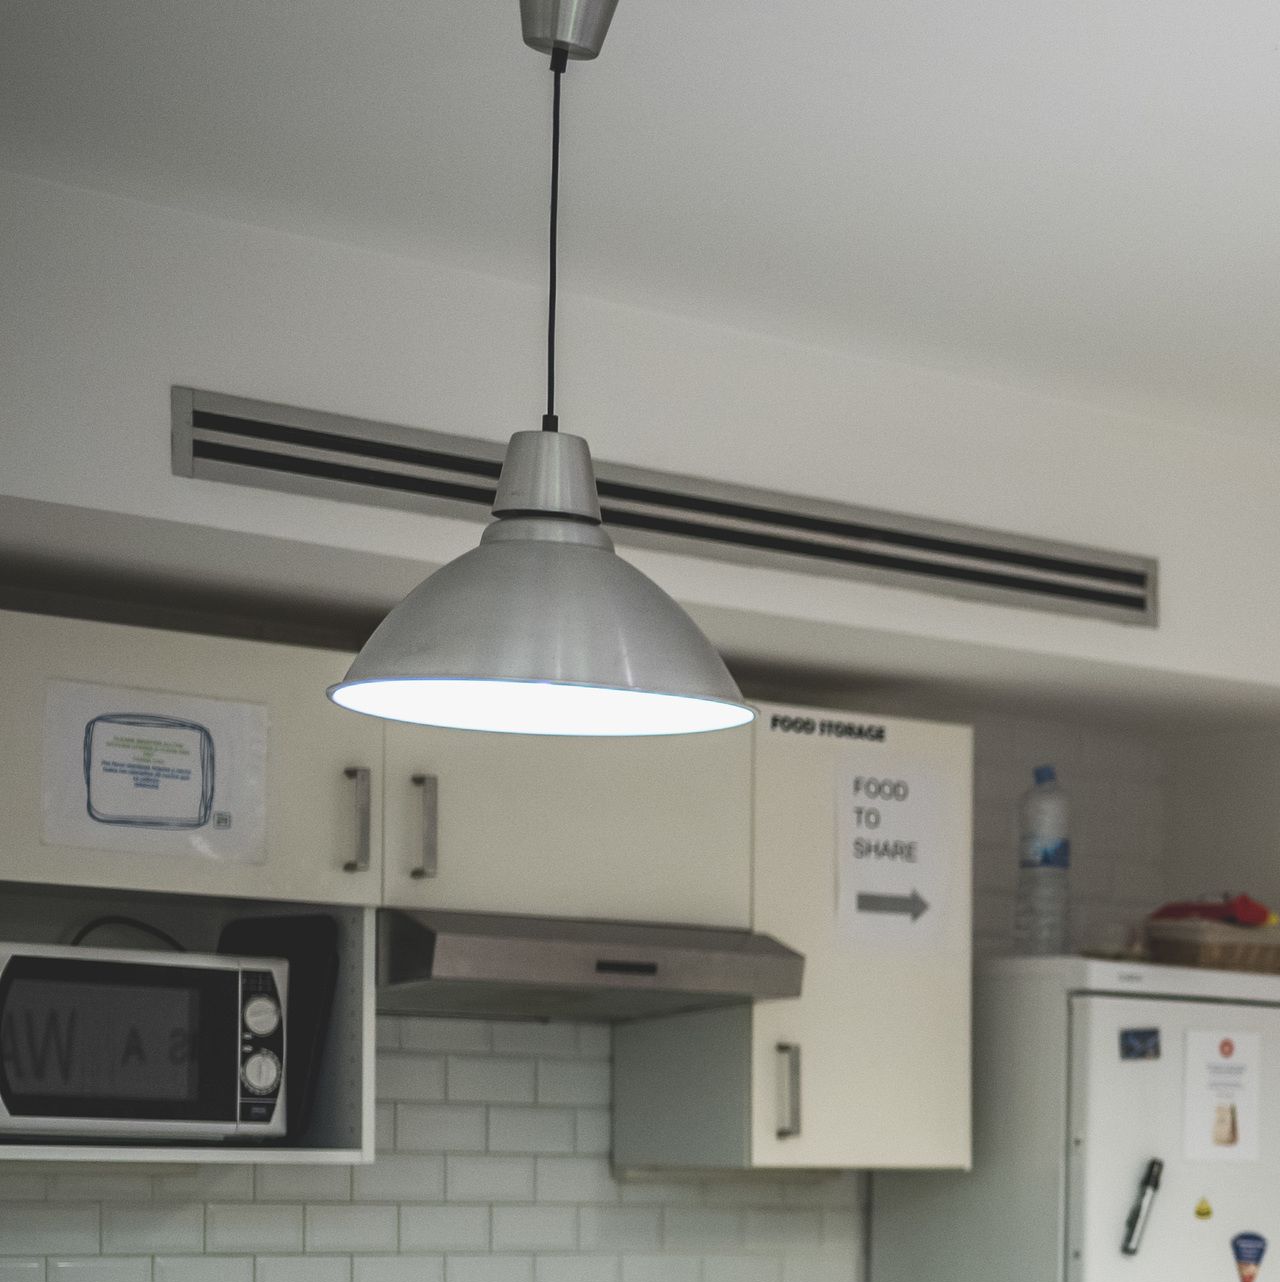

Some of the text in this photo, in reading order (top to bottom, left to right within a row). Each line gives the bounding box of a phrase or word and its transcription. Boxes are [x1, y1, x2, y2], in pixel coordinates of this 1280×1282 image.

[770, 714, 886, 743] FOOD STORAGE
[852, 775, 910, 802] FOOD
[853, 806, 882, 830] TO
[852, 837, 918, 864] SHARE
